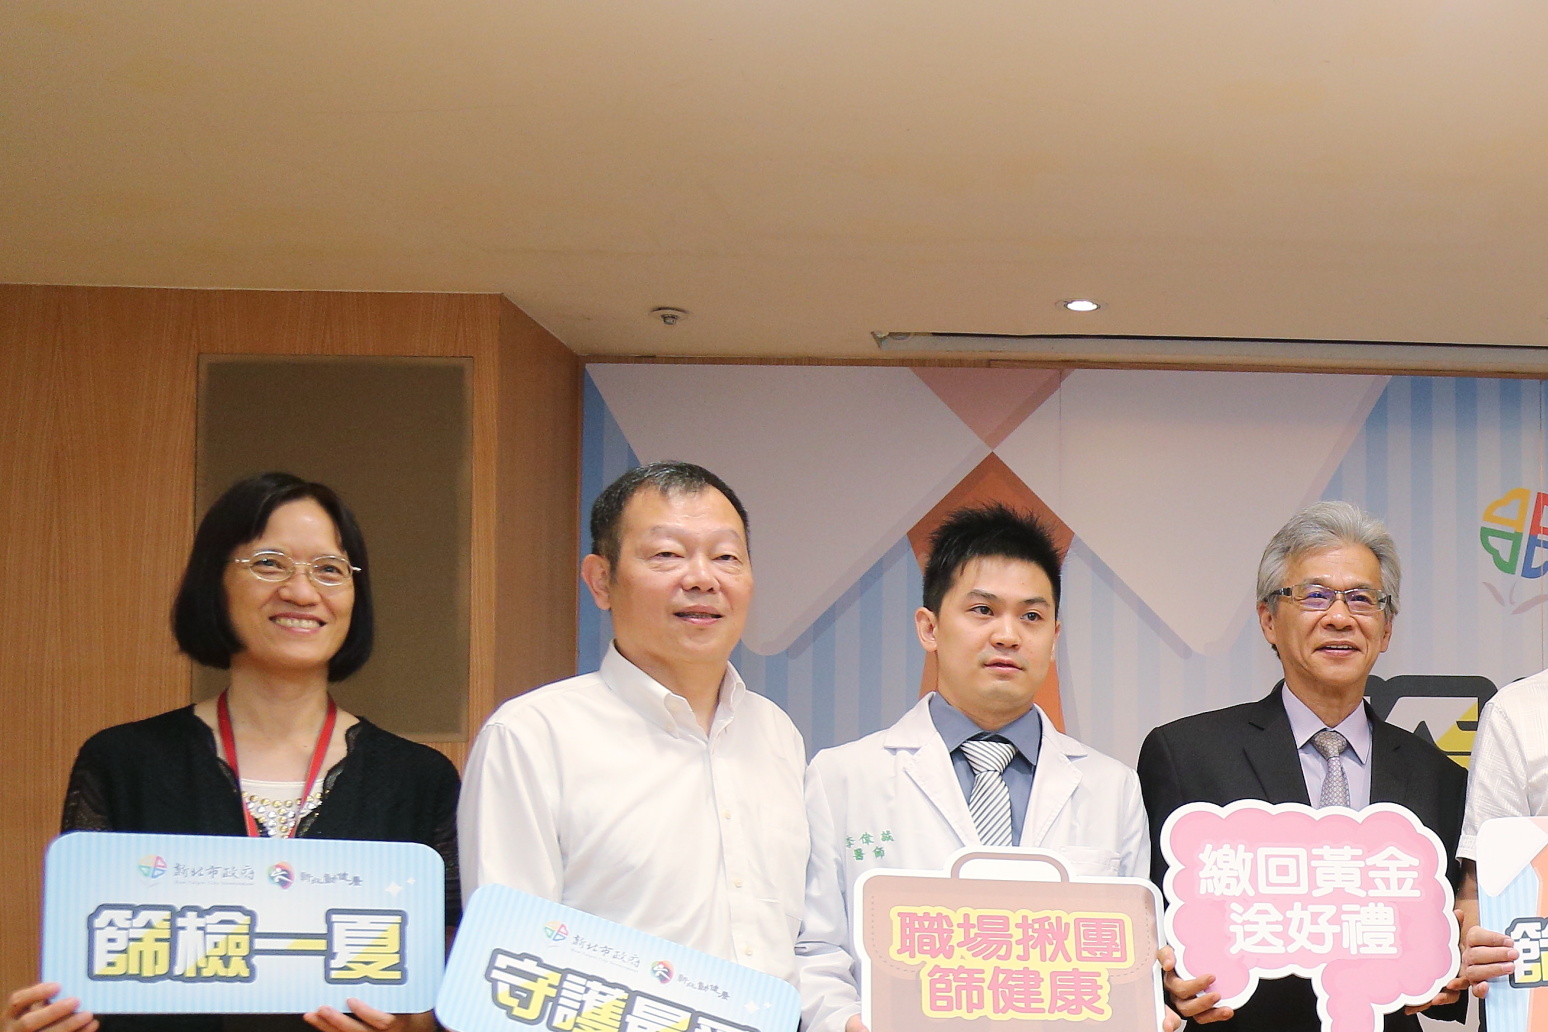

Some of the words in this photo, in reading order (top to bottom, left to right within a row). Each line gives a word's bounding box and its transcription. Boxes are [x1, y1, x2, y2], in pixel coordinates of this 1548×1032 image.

[1198, 843, 1422, 898] 繳回黃金
[91, 907, 403, 981] 篩檢一夏
[897, 911, 1128, 963] 職場揪團
[1229, 901, 1398, 955] 送好禮
[927, 964, 1105, 1016] 篩健康
